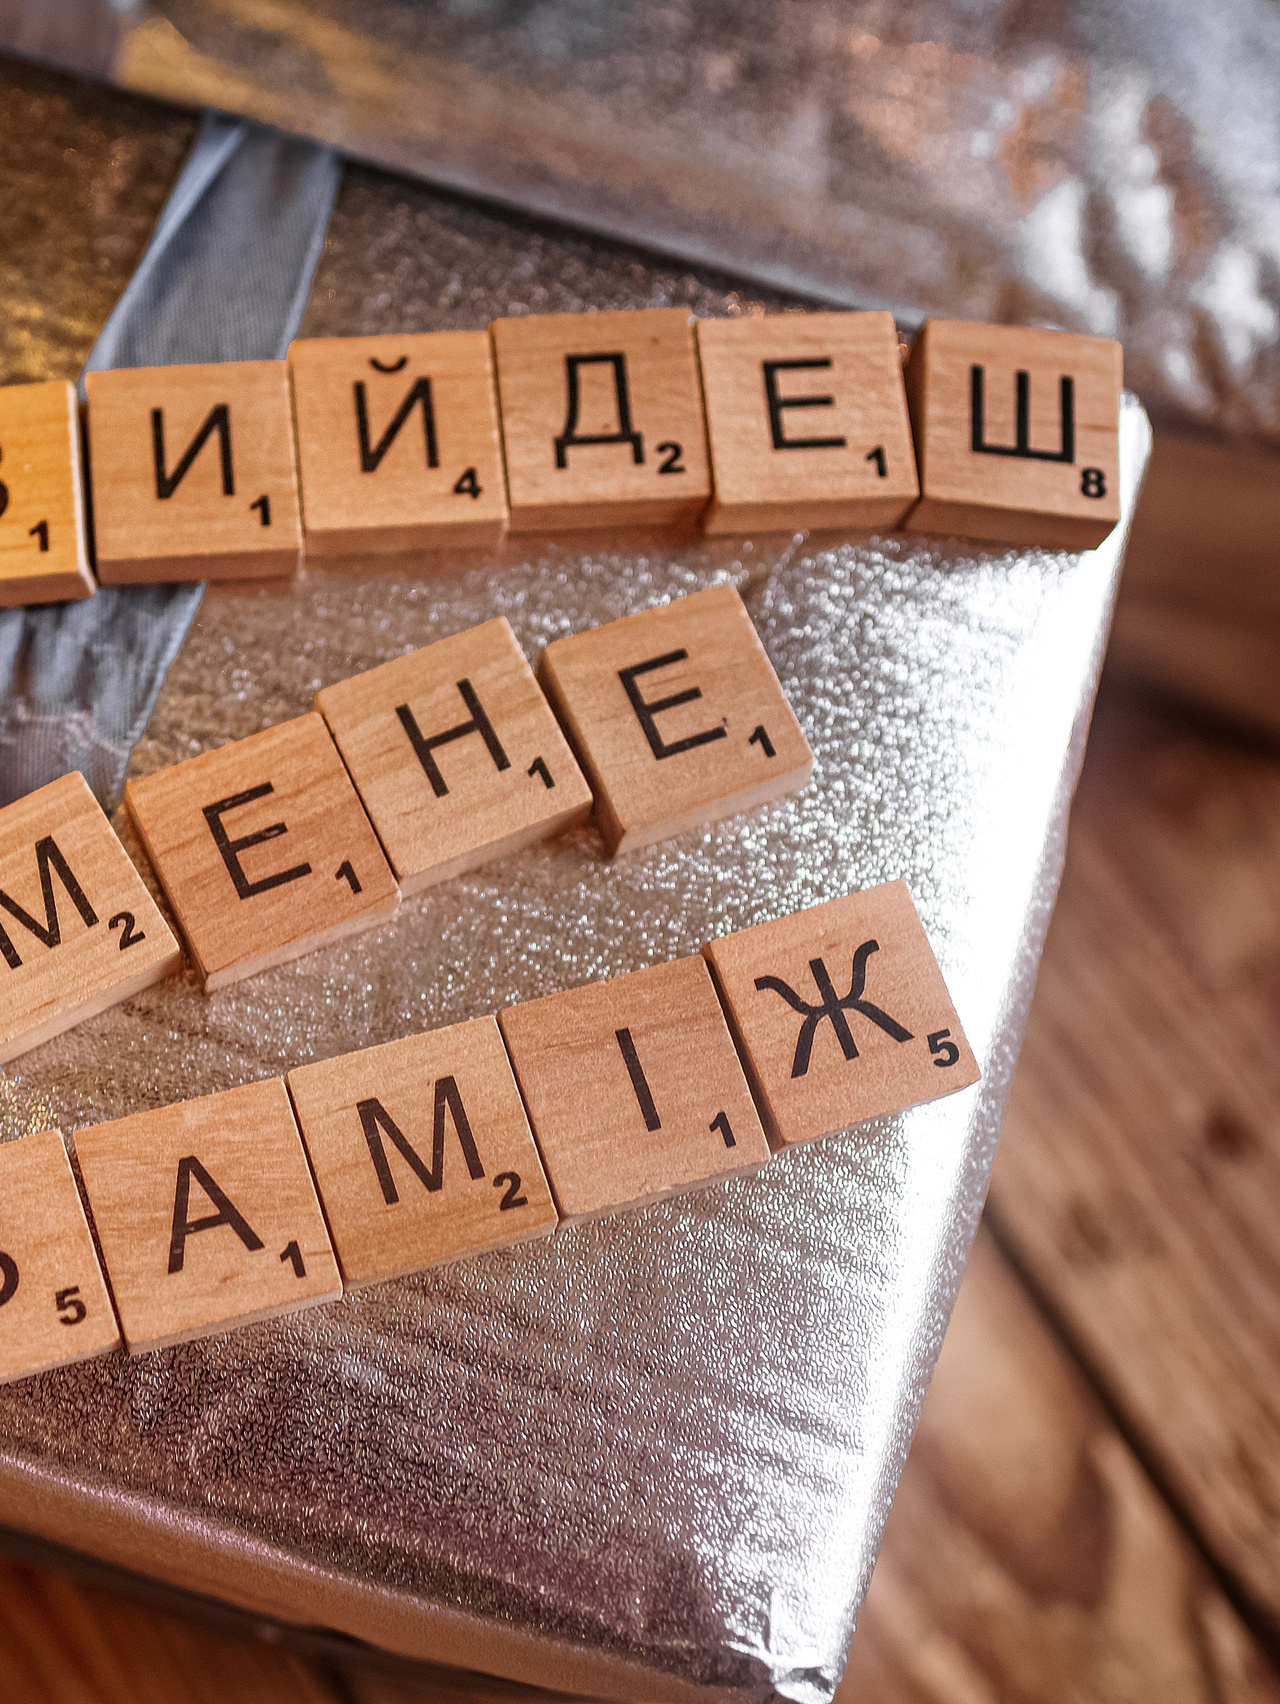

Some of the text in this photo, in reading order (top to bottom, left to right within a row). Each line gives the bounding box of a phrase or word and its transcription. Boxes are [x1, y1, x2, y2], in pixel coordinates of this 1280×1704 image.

[28, 440, 1108, 553] 1 1 4 2 1 8
[107, 724, 778, 952] 2 1 1 1
[54, 1027, 961, 1327] 5 1 2 1 5
